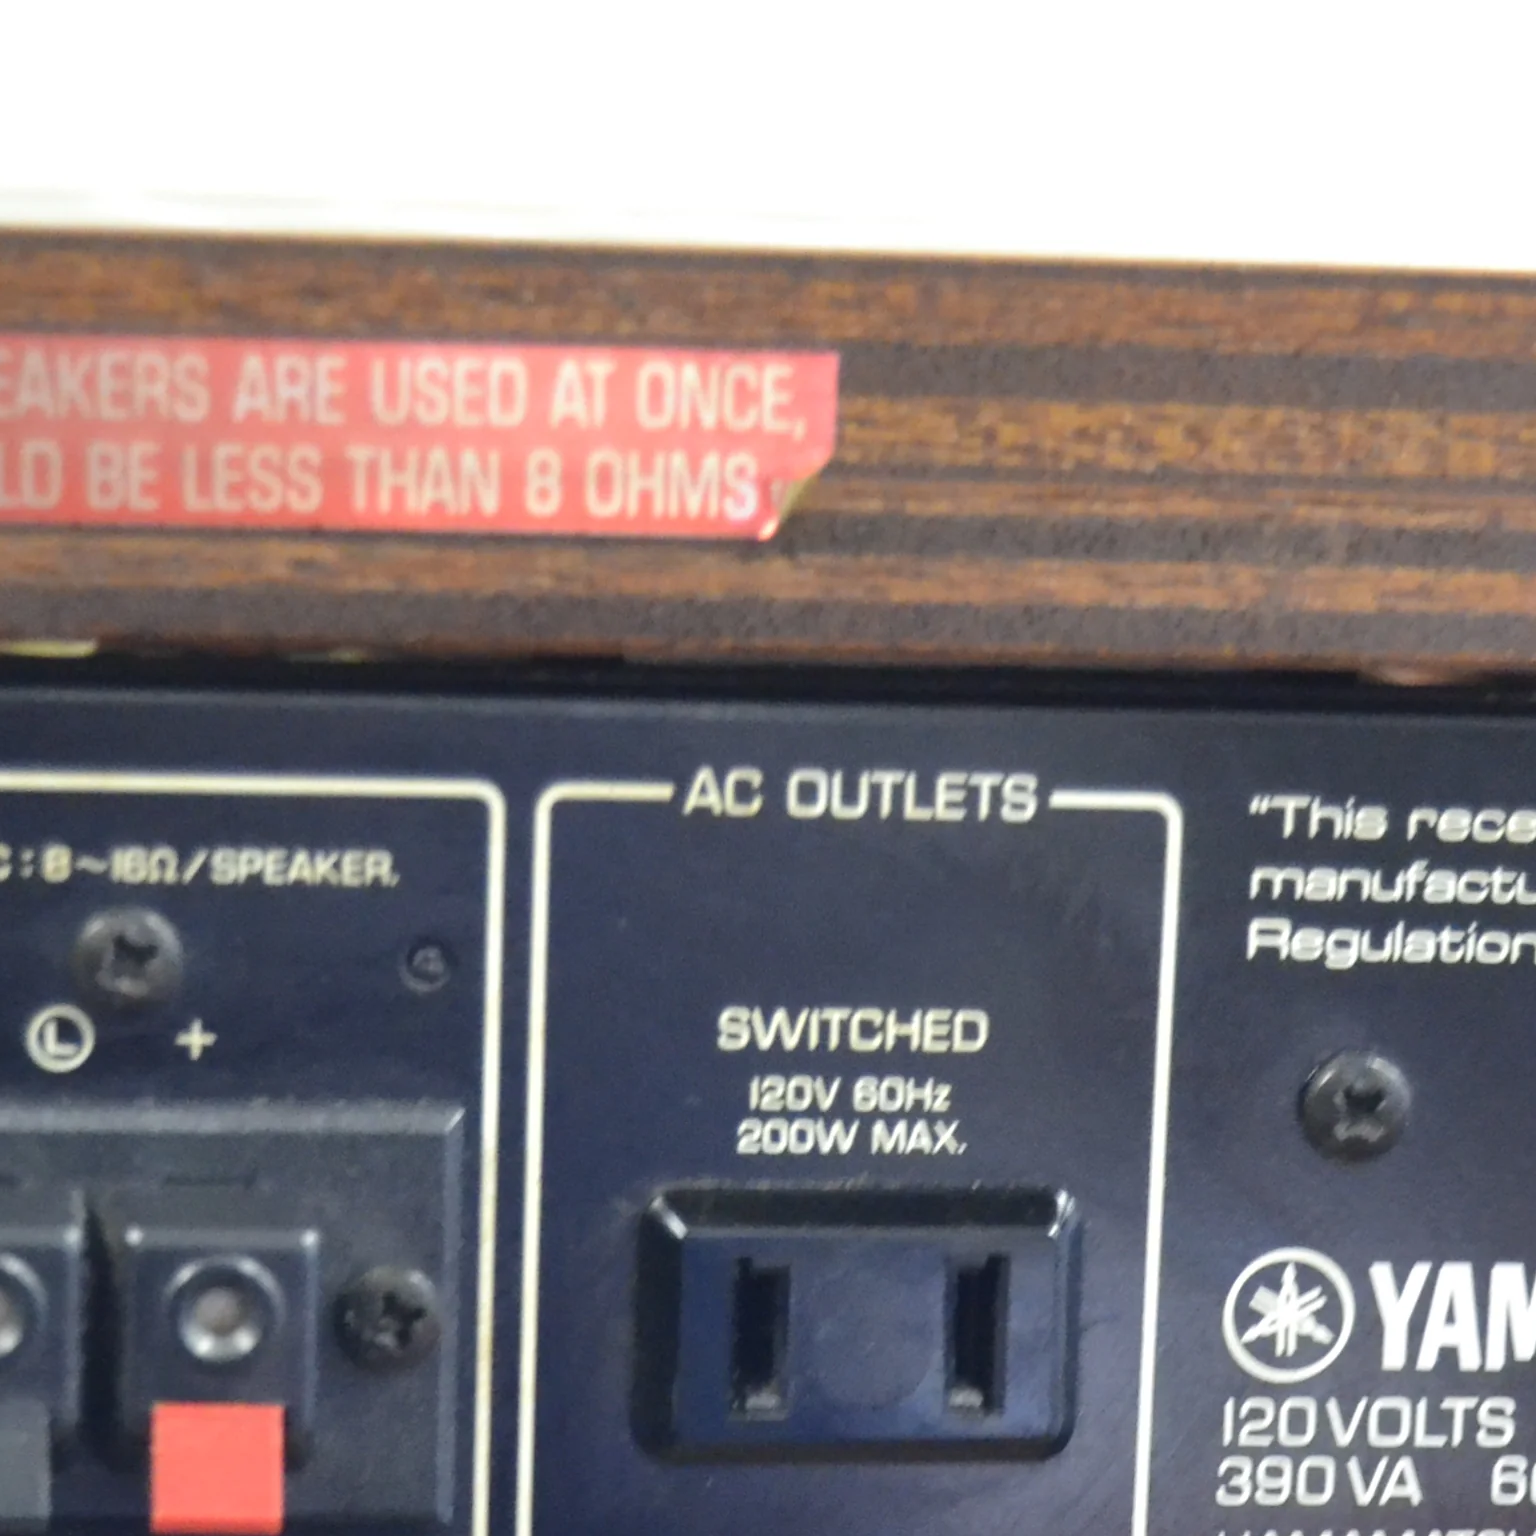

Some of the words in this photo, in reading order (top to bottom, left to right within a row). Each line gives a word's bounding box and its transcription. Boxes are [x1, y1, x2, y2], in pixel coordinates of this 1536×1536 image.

[231, 353, 346, 425] ARE
[371, 357, 527, 427] USED
[549, 358, 614, 428] AT
[634, 361, 805, 441] ONCE,
[86, 440, 162, 512] BE
[181, 443, 323, 514] LESS
[344, 444, 501, 516] THAN
[525, 446, 562, 517] 8
[684, 767, 762, 816] AC
[787, 769, 1037, 822] OUTLETS
[718, 1007, 988, 1052] SWITCHED
[749, 1076, 839, 1112] 120V
[853, 1076, 951, 1112] 60Hz
[737, 1118, 859, 1154] 200W
[1216, 1456, 1335, 1506] 390
[1347, 1456, 1422, 1505] VA
